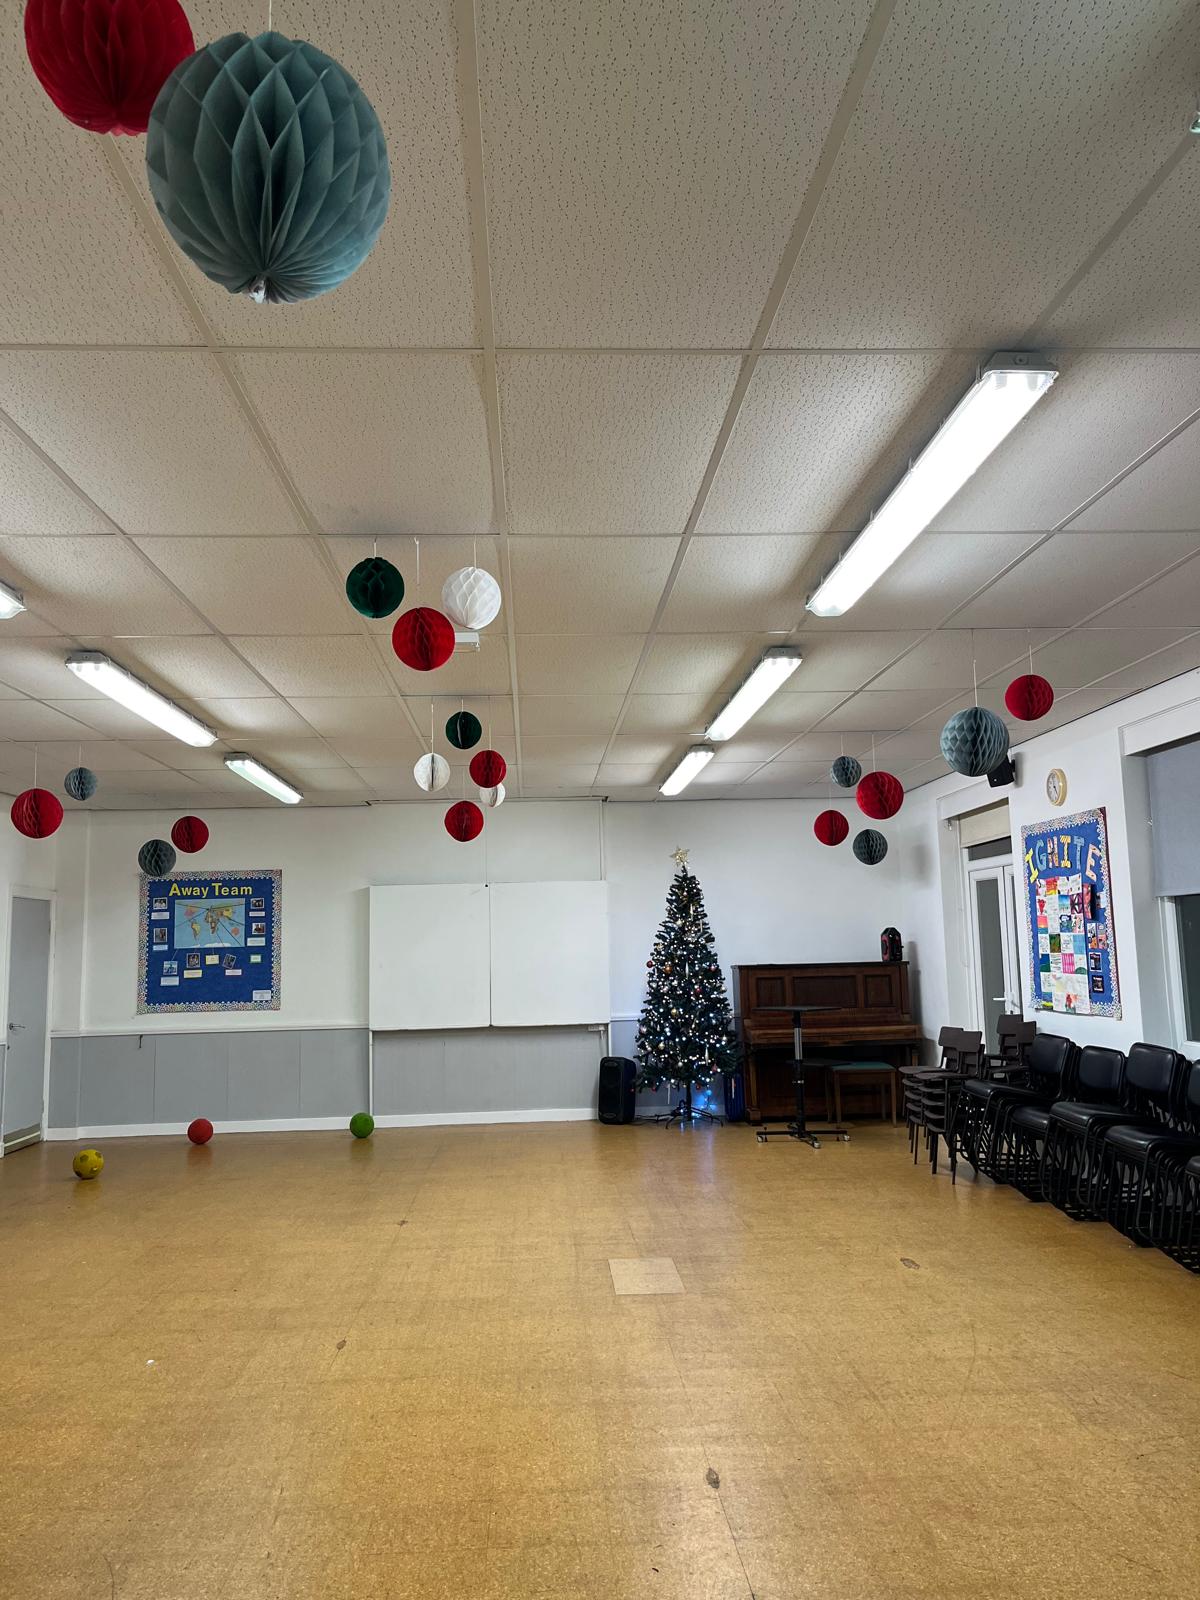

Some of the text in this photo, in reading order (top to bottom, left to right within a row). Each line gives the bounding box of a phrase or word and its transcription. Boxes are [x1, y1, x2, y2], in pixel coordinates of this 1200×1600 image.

[1025, 835, 1101, 883] IGNITE
[169, 883, 252, 898] Away Team
